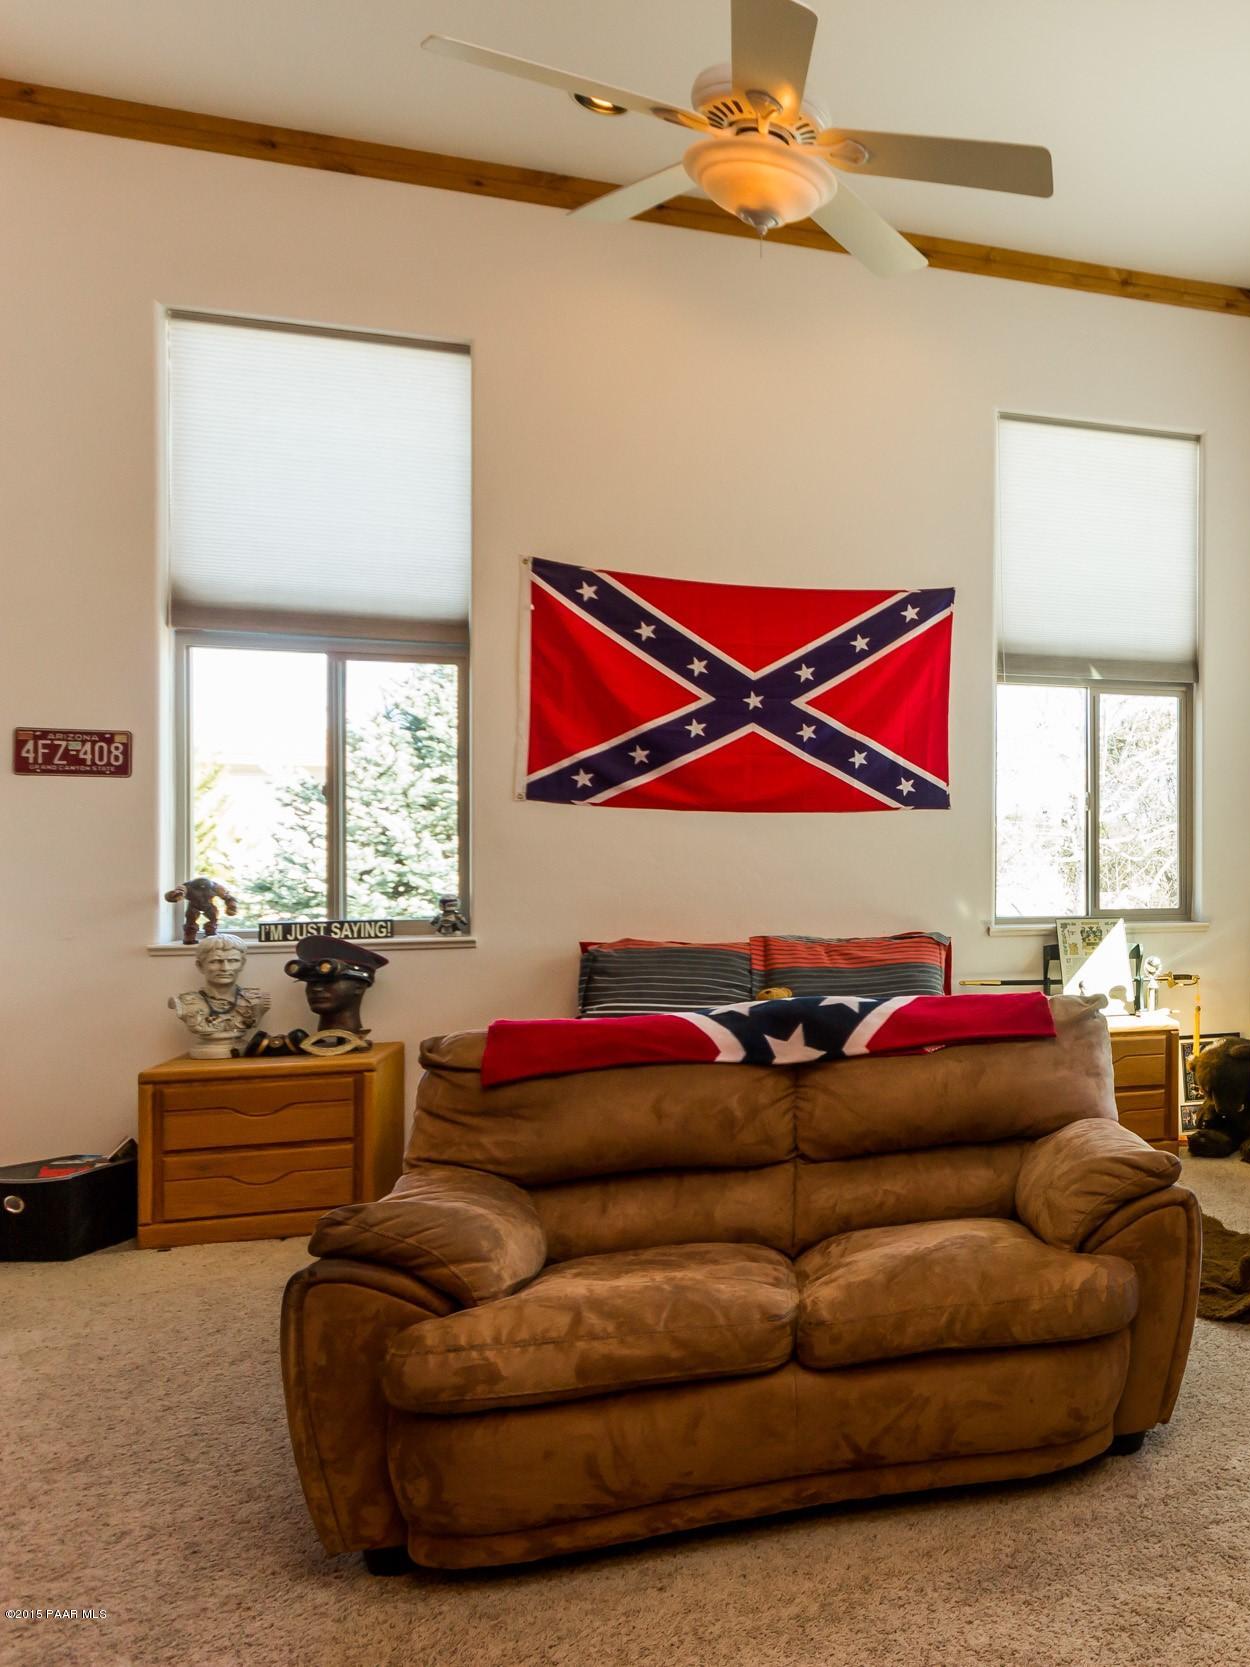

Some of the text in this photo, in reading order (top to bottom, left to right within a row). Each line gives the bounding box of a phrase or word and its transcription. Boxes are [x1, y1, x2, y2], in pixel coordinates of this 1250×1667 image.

[47, 733, 100, 741] ARIZONA
[260, 921, 392, 941] I'M JUST SAYING!
